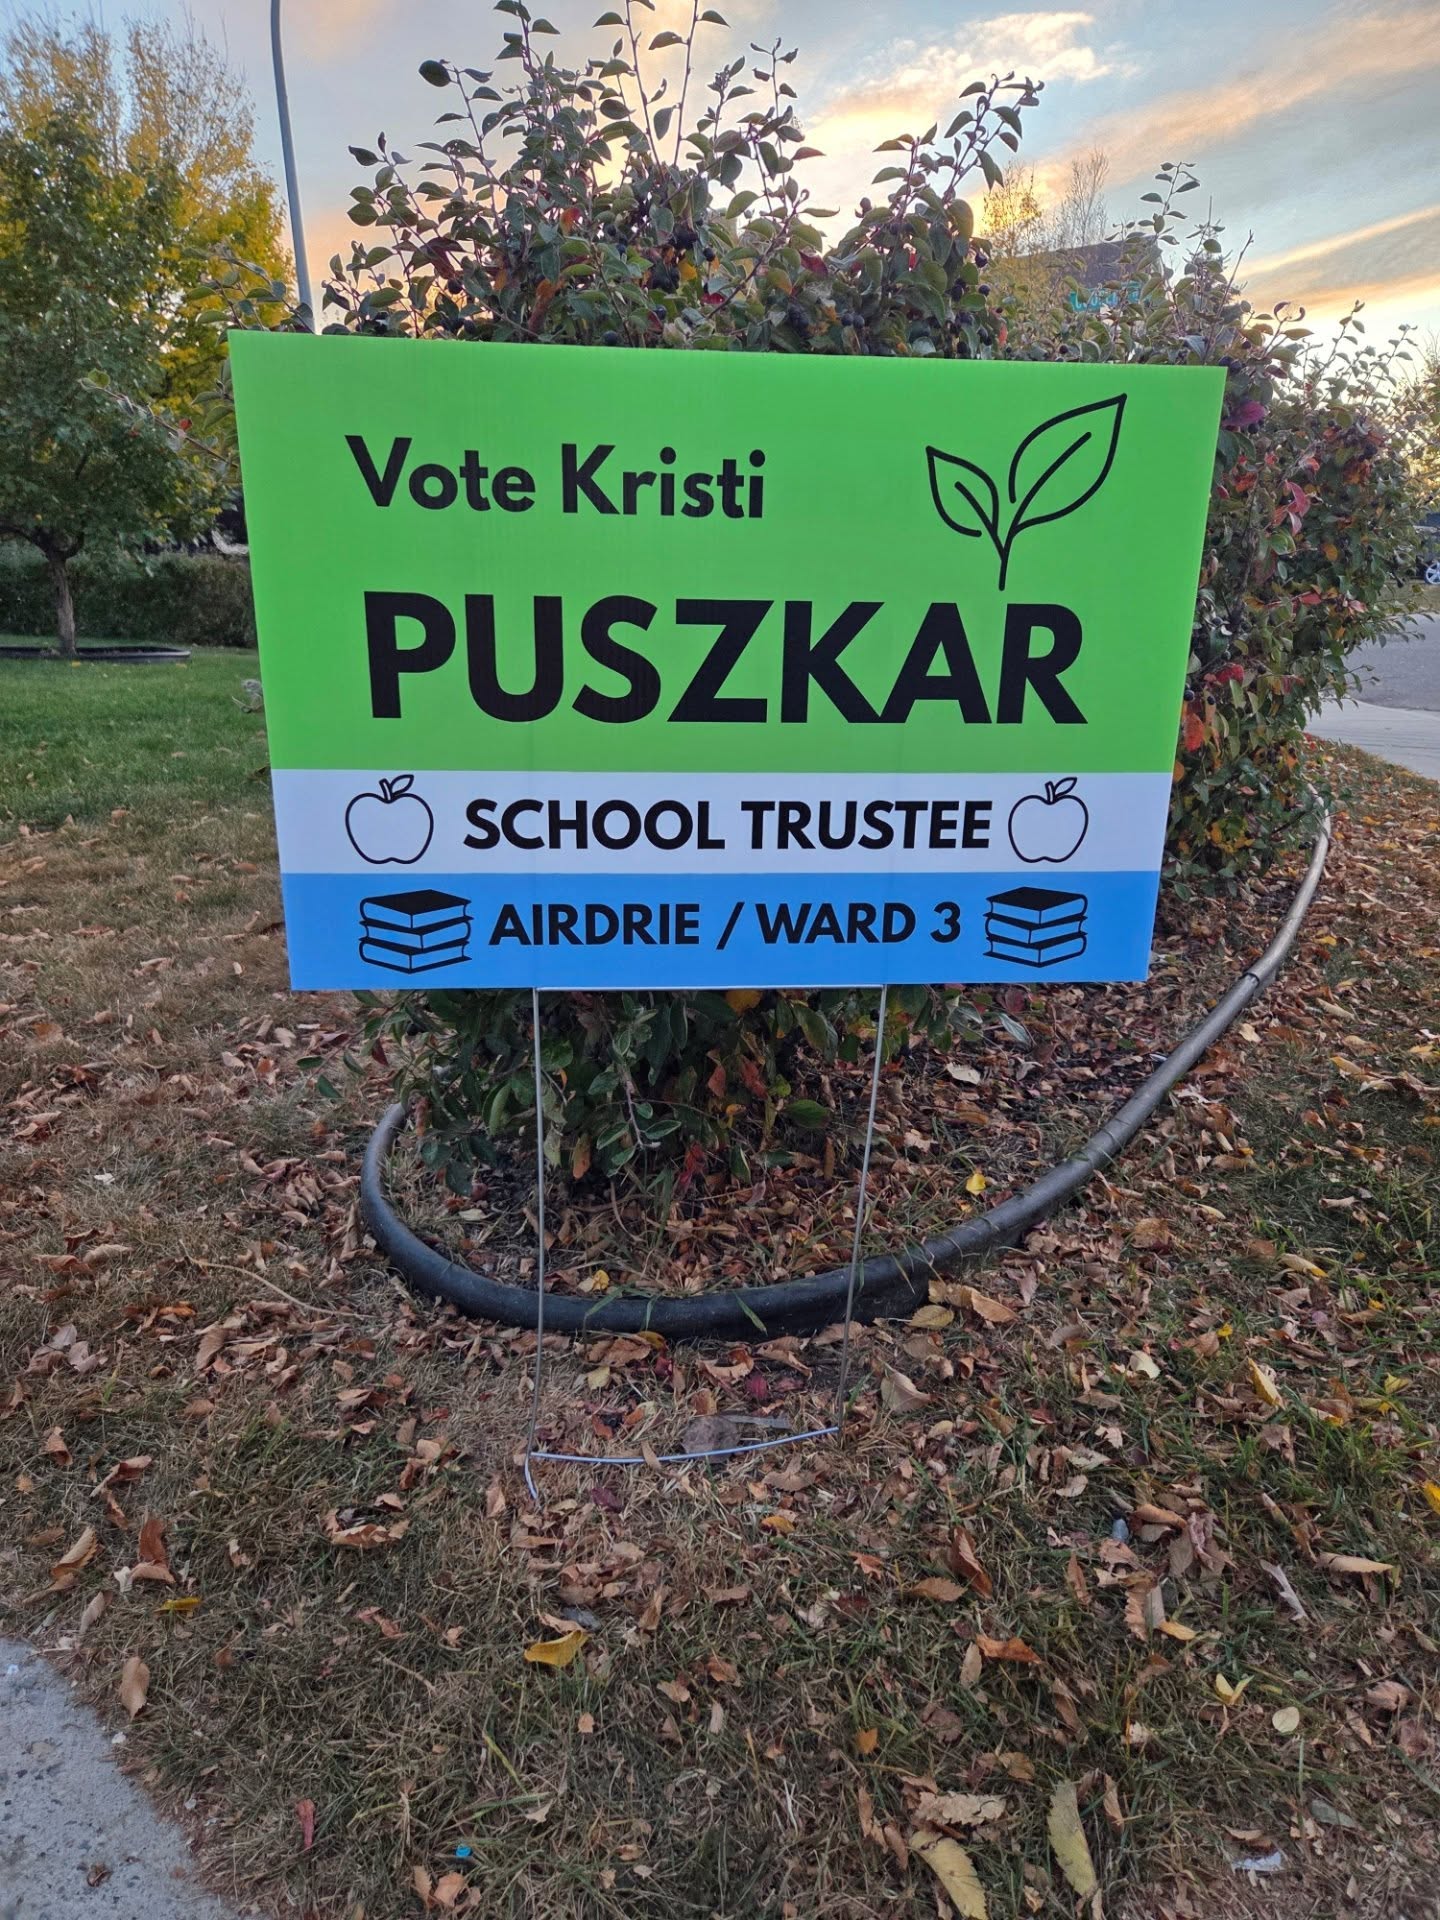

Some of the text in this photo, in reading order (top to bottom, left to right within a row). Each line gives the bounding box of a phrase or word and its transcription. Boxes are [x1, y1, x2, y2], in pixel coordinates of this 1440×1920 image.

[345, 434, 767, 520] Vote Kristi
[364, 591, 1088, 725] PUSZKAR
[463, 799, 994, 851] SCHOOL TRUSTEE
[489, 901, 962, 951] AIRDRIE / WARD 3
